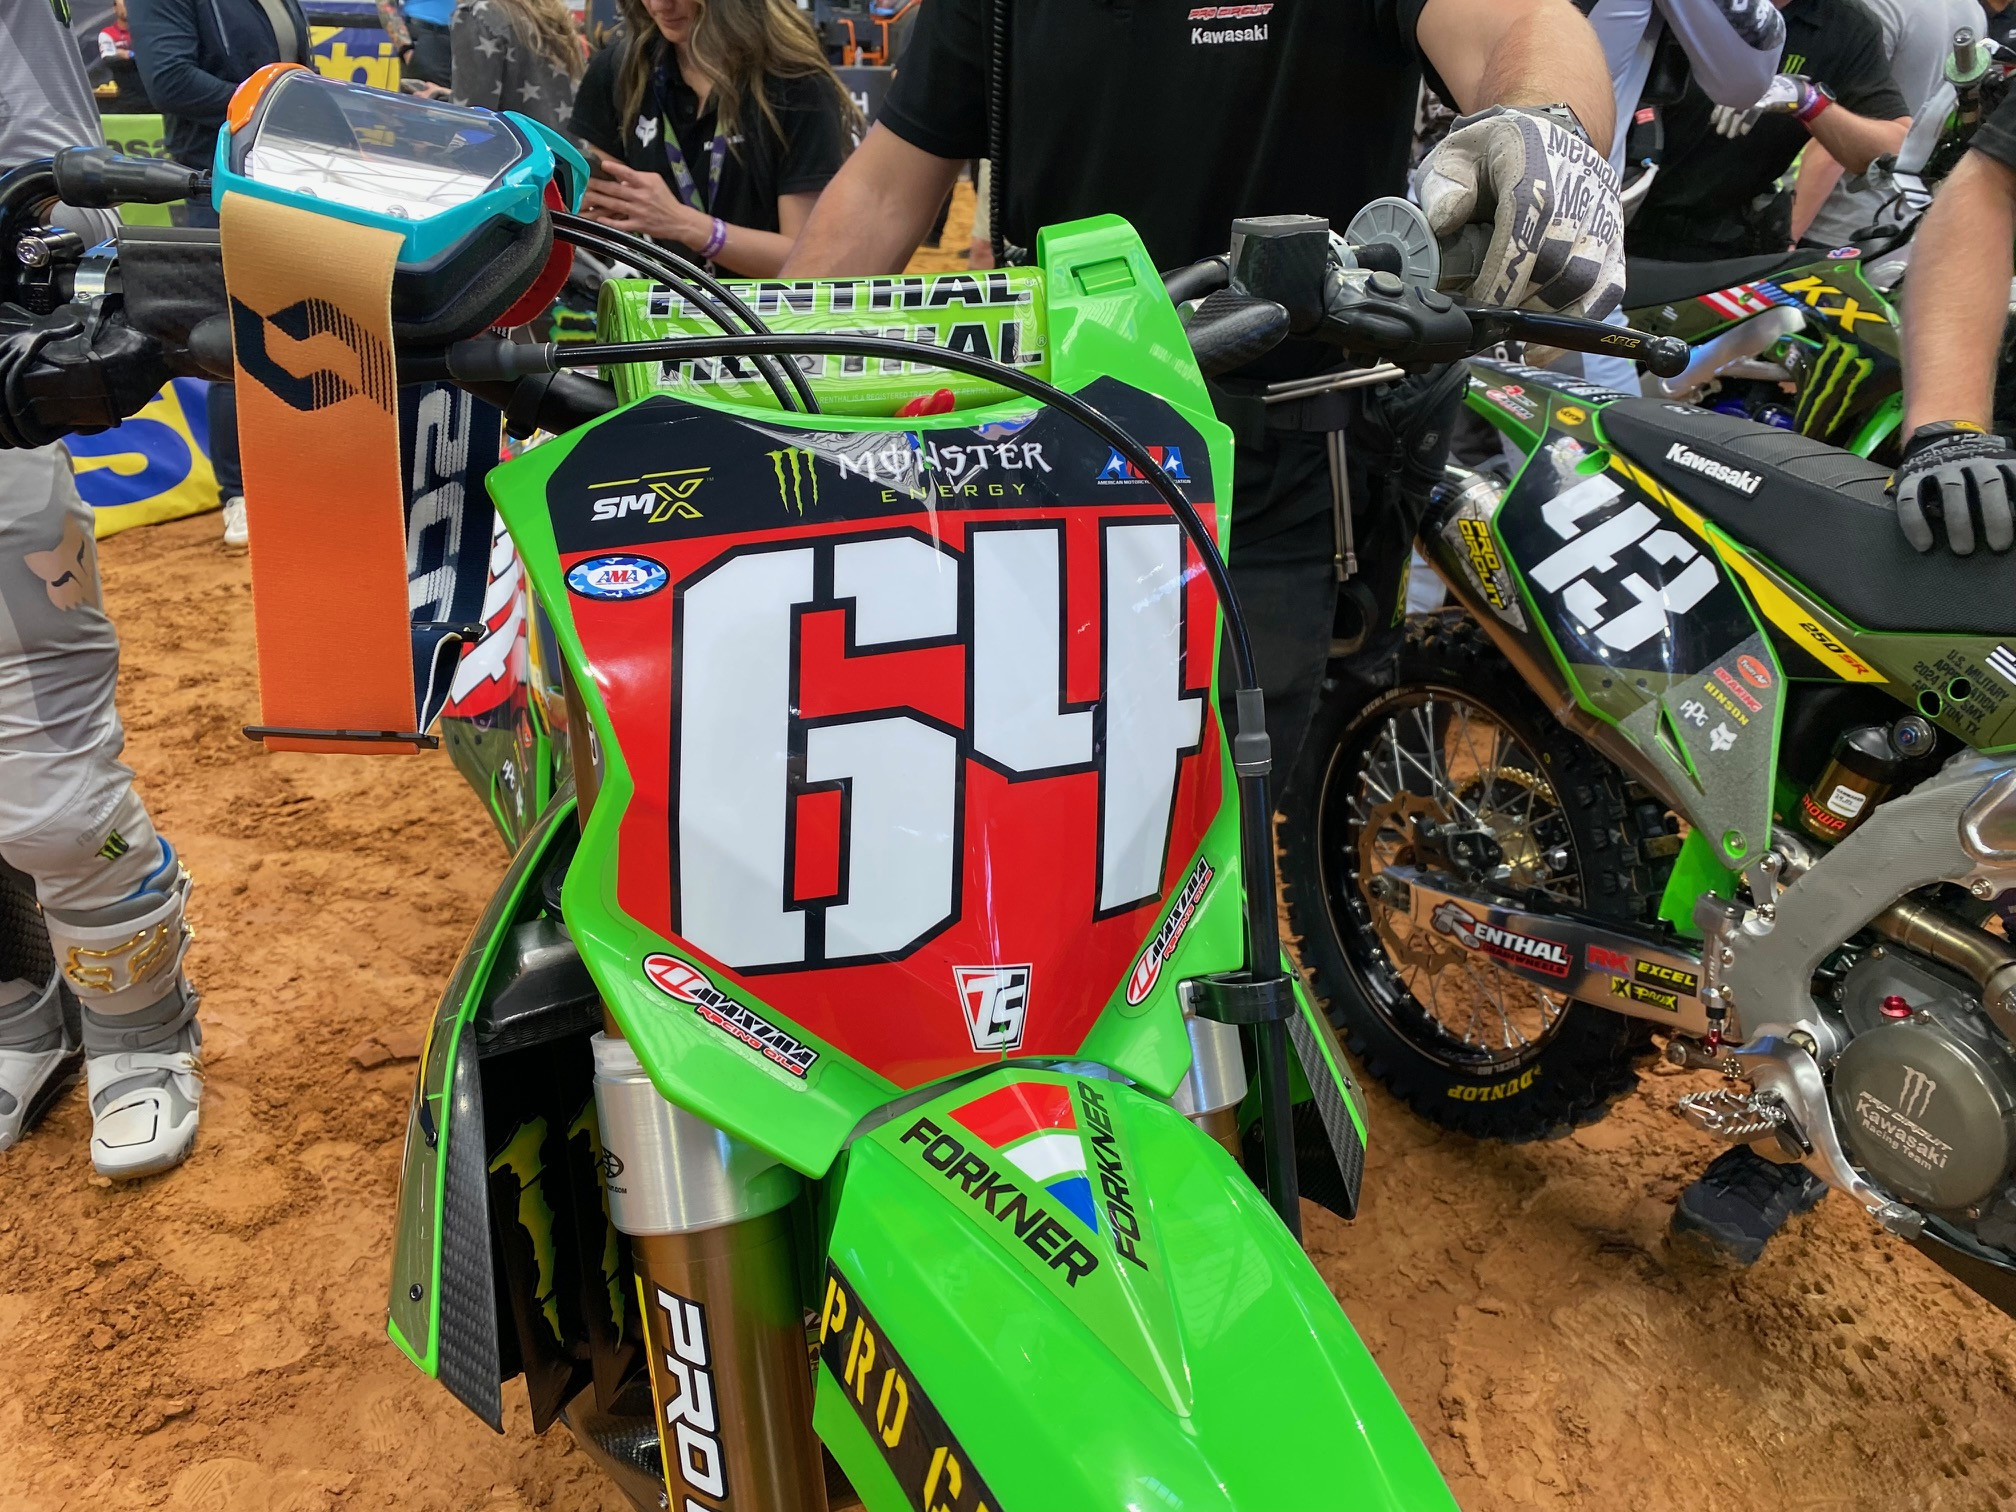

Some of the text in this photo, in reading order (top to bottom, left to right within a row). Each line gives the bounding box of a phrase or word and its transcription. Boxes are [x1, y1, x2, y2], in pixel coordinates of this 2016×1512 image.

[1191, 24, 1268, 44] Kawasaki
[1780, 275, 1888, 333] KX
[820, 396, 849, 404] RENTHAL
[866, 391, 908, 400] REGISTERED
[837, 441, 1053, 482] MONSTER
[1665, 442, 1763, 494] Kawasaki
[590, 478, 704, 523] SMX
[881, 483, 1026, 503] ENERGY
[1457, 518, 1505, 610] CIRCUIT
[1472, 519, 1501, 570] PRO
[1529, 473, 1720, 652] 43
[596, 570, 640, 583] AMA
[1703, 681, 1749, 726] HINSON
[1964, 664, 2010, 703] MILITARY
[670, 515, 1209, 975] 64
[1803, 792, 1847, 830] HOWA
[1587, 944, 1631, 973] RK
[1637, 961, 1696, 987] EXCEL
[697, 1005, 805, 1077] RACING OILS
[1447, 1067, 1535, 1101] DUNLOP
[1856, 1099, 1948, 1169] Kawasaki
[1862, 1118, 1933, 1171] Racing Team
[1076, 1080, 1149, 1272] FORKNER
[899, 1116, 1099, 1288] FORKNER
[818, 1275, 909, 1449] PRO
[657, 1288, 725, 1498] PRO
